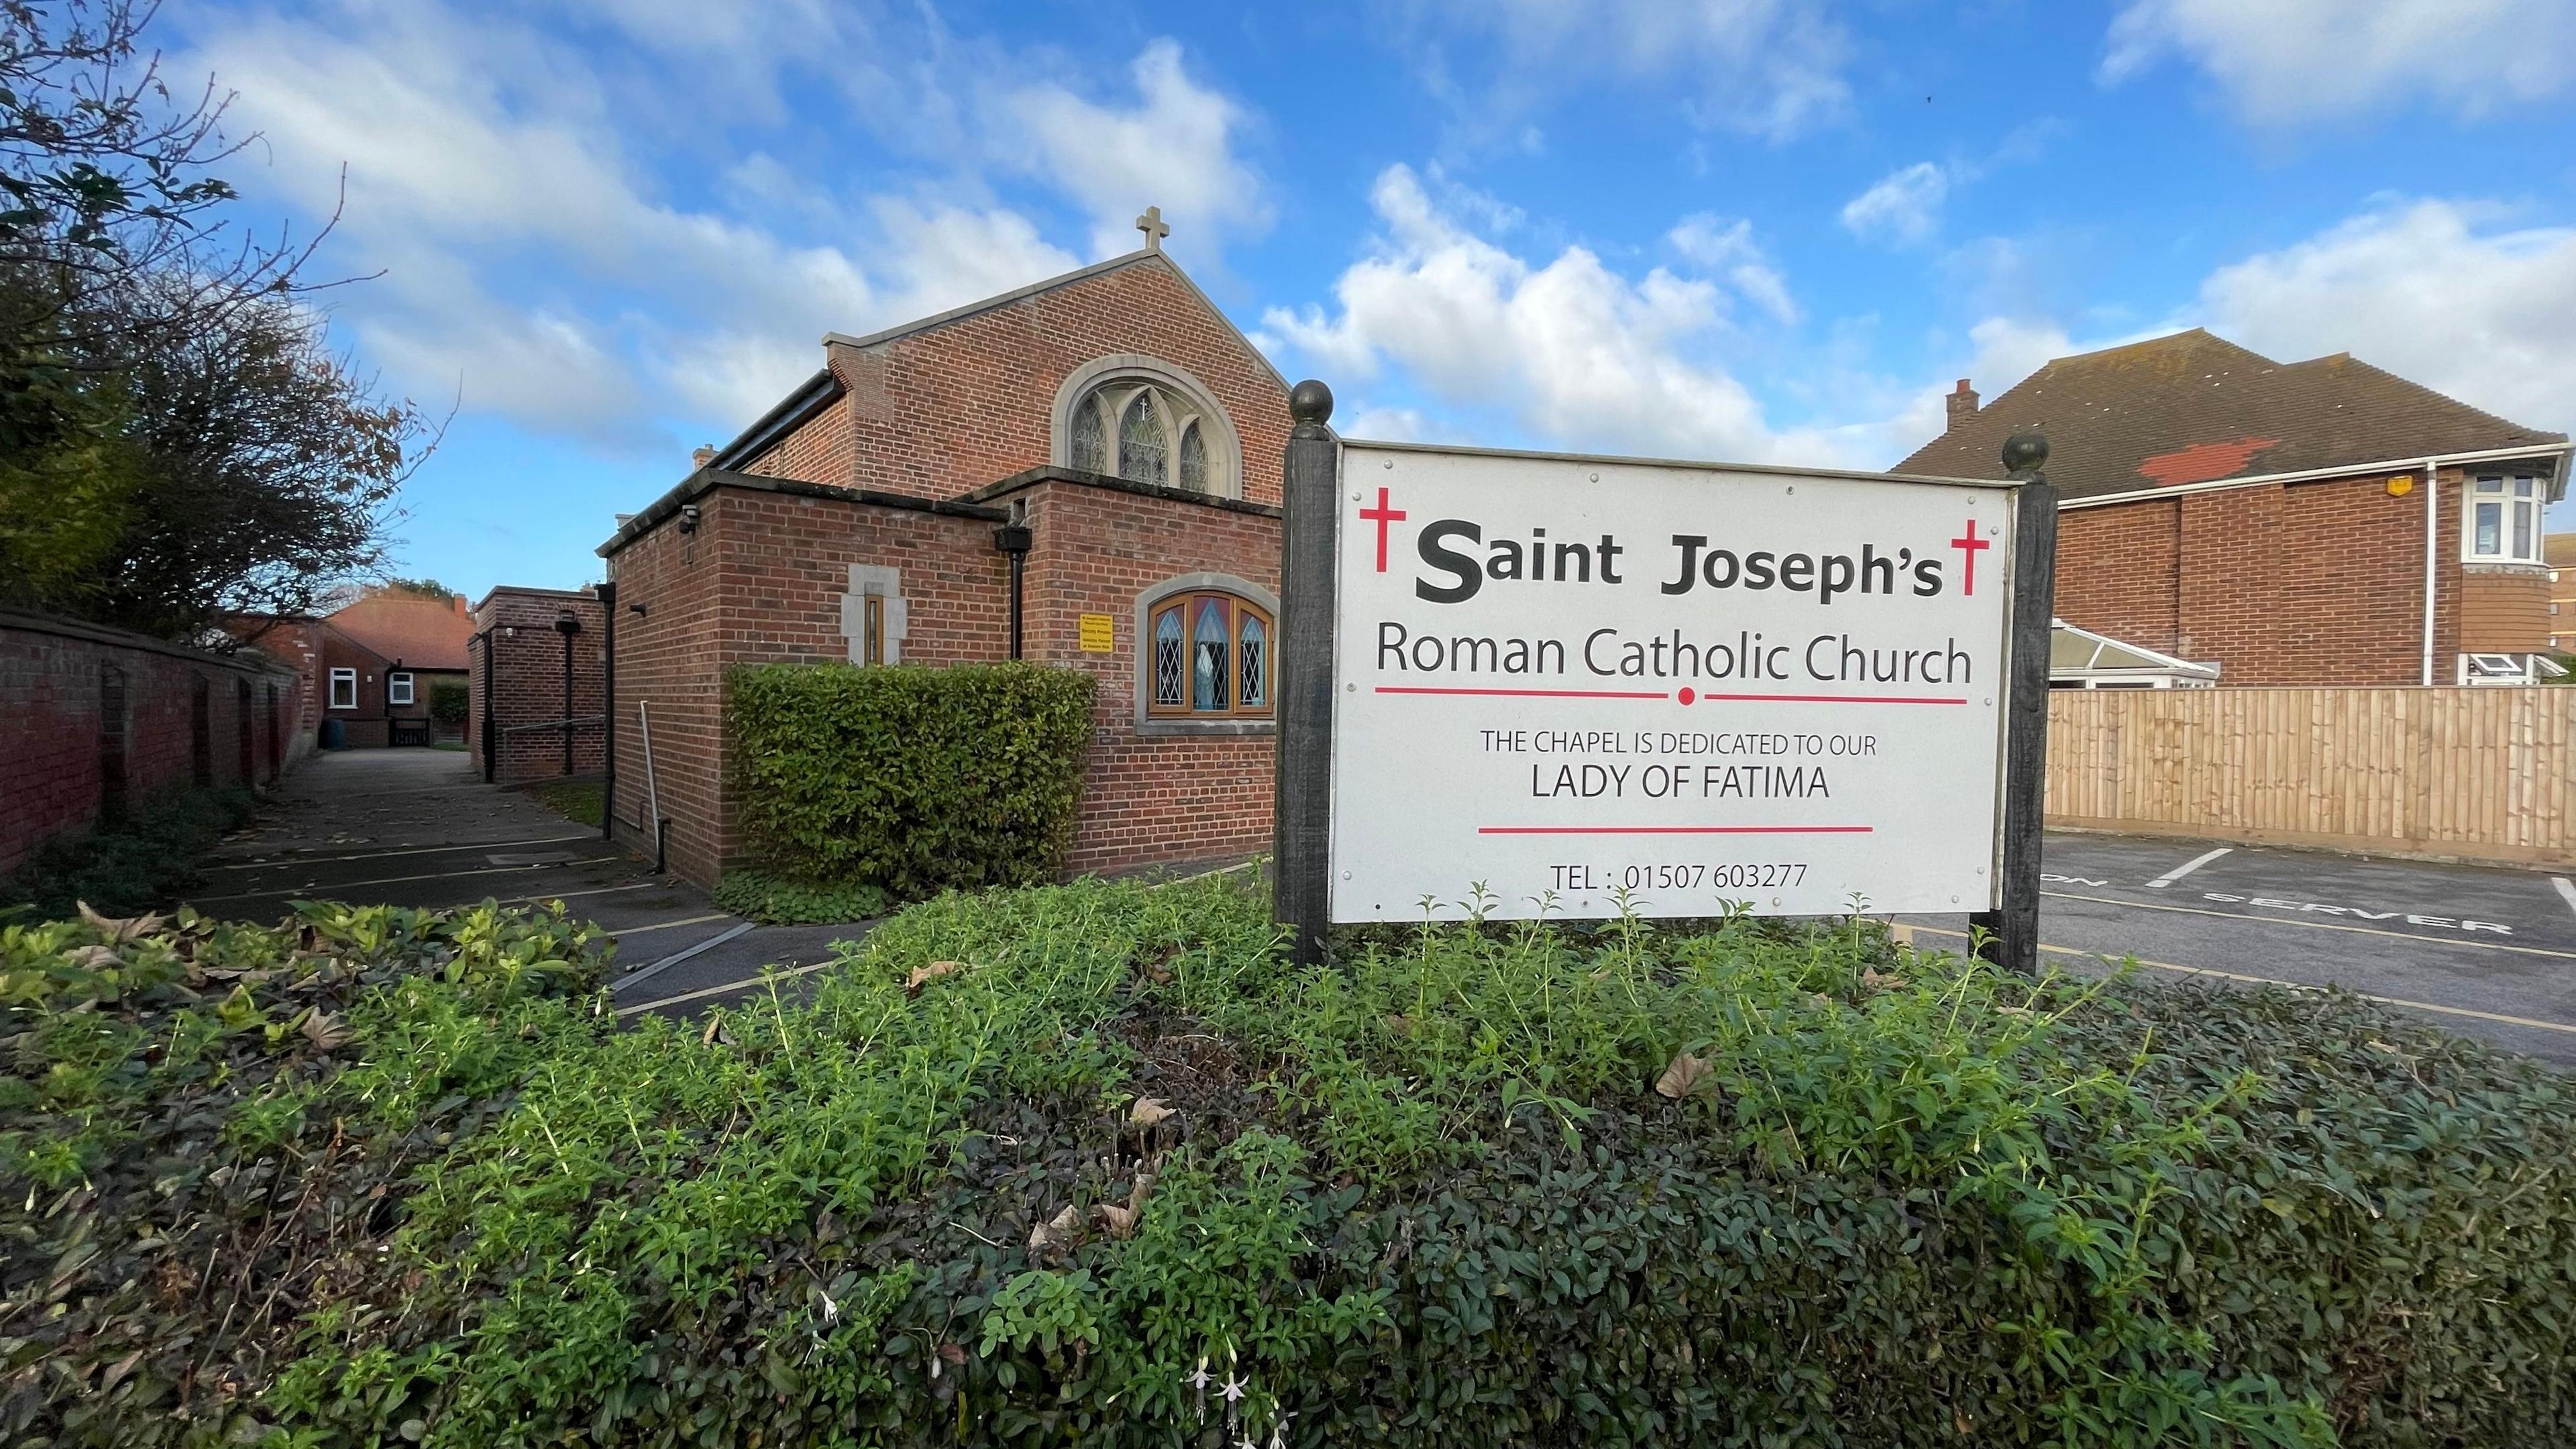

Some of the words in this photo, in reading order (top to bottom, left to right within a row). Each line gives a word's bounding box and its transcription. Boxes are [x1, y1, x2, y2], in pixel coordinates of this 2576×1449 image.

[1415, 519, 1623, 604] Saint
[1661, 534, 1943, 605] Joseph's
[1377, 622, 1565, 674] Roman
[1584, 629, 1790, 681] Catholic
[1806, 634, 1971, 684] Church
[1480, 730, 1527, 752] THE
[1534, 731, 1627, 753] CHAPEL
[1635, 733, 1653, 753] IS
[1661, 733, 1788, 755] DEDICATED
[1793, 735, 1823, 755] TO
[1829, 735, 1876, 755] OUR
[1532, 764, 1632, 798] LADY
[1642, 765, 1690, 798] OF
[1704, 765, 1830, 798] FATIMA
[1625, 865, 1705, 890] 01507
[1714, 864, 1808, 888] 603277
[2202, 892, 2514, 935] SERVER
